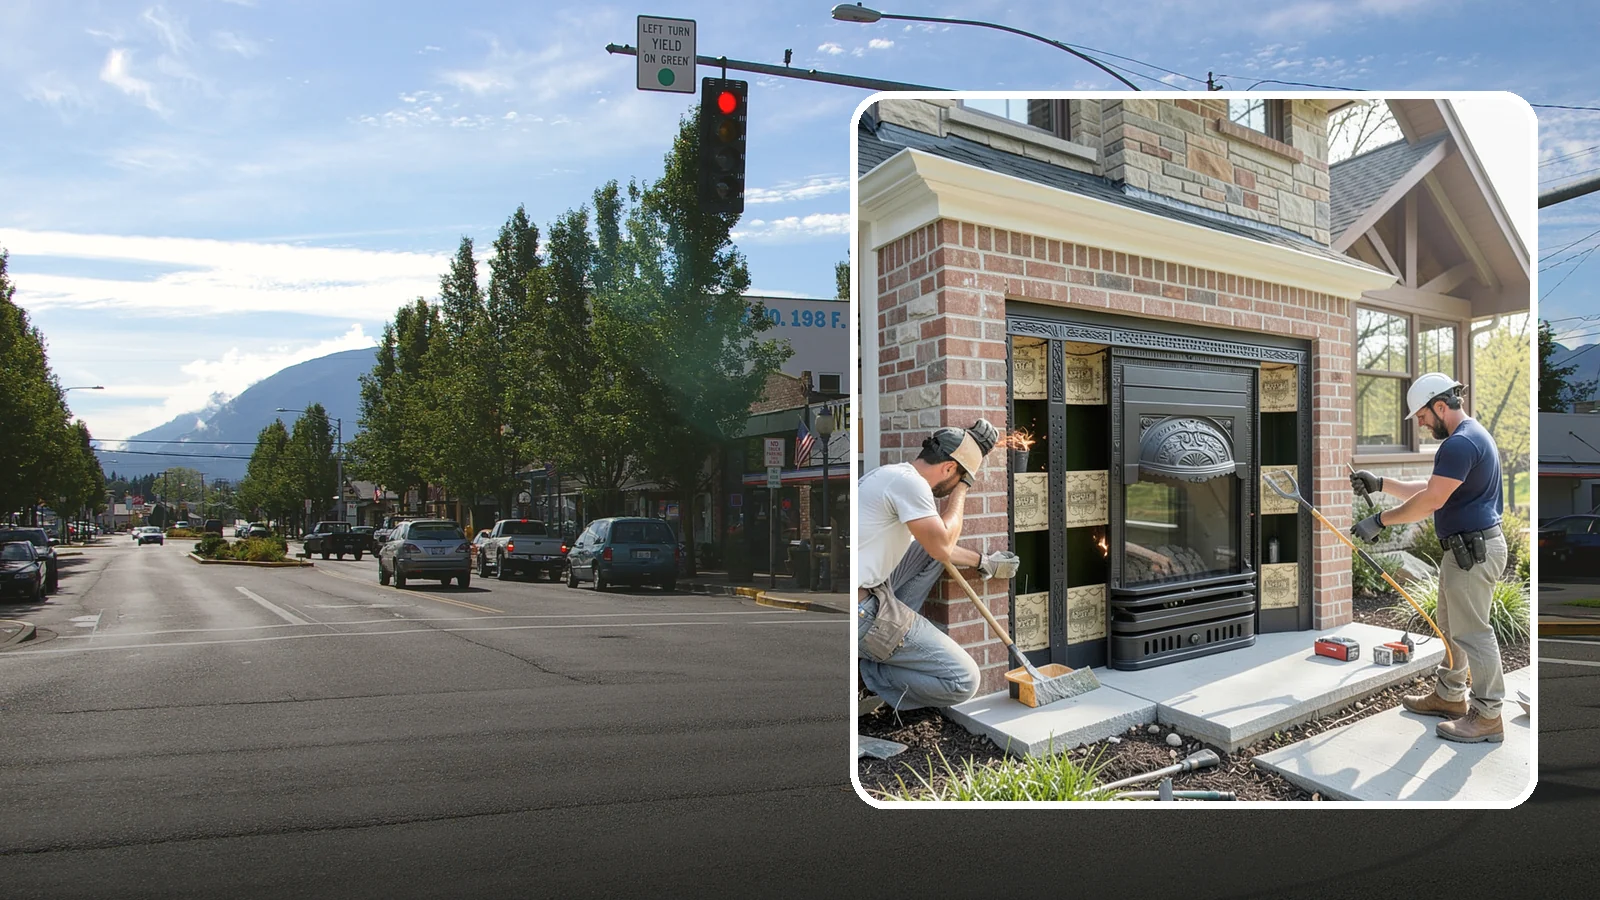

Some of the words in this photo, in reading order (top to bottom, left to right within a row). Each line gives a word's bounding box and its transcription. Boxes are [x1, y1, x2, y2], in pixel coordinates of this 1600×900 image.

[643, 23, 663, 34] LEFT
[668, 25, 690, 36] TURN
[652, 37, 682, 52] YIELD
[644, 53, 656, 63] ON
[661, 54, 689, 66] GREEN
[791, 309, 826, 328] 198
[831, 311, 846, 329] F.
